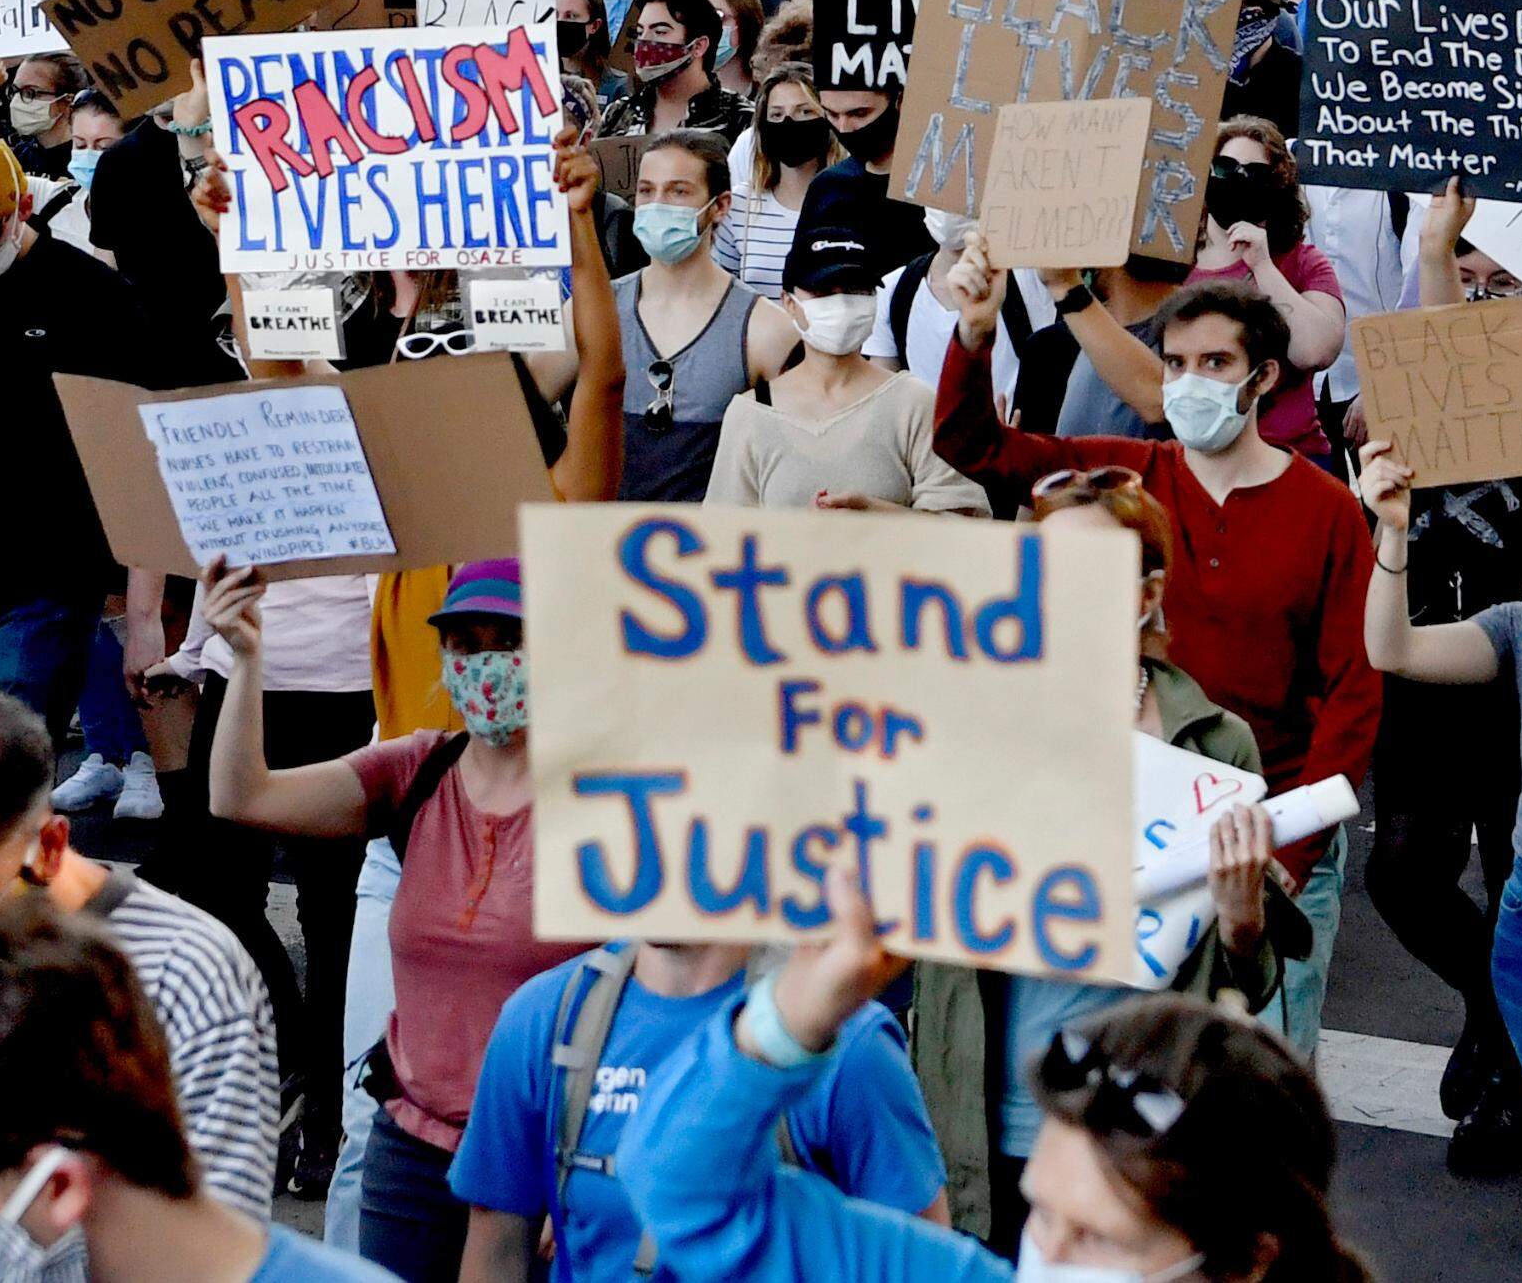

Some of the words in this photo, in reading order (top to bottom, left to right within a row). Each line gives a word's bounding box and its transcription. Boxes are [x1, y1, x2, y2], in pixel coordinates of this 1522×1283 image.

[1317, 35, 1361, 66] To
[1370, 39, 1435, 69] End
[1439, 40, 1504, 74] The
[1311, 70, 1372, 104] We
[1379, 70, 1488, 102] Become
[234, 25, 558, 193] RACISM
[1315, 105, 1414, 140] About
[1419, 109, 1477, 138] The
[1303, 138, 1380, 170] That
[1388, 145, 1499, 177] Matter
[231, 162, 401, 253] LIVES
[410, 153, 559, 250] HERE
[289, 254, 390, 270] JUSTICE
[405, 251, 441, 267] FOR
[456, 249, 523, 266] OSAZE
[251, 316, 333, 332] BREATHE
[475, 308, 561, 326] BREATHE
[1359, 315, 1522, 372] BLACK
[1371, 361, 1513, 422] LIVES
[186, 494, 238, 512] PEOPLE
[249, 489, 277, 503] ALL
[283, 484, 314, 498] THE
[319, 479, 356, 493] TIME
[196, 530, 248, 551] WITHOUT
[254, 523, 322, 543] CRUSHING
[615, 515, 1045, 665] Stand
[776, 678, 926, 759] For
[570, 770, 1103, 973] Justice
